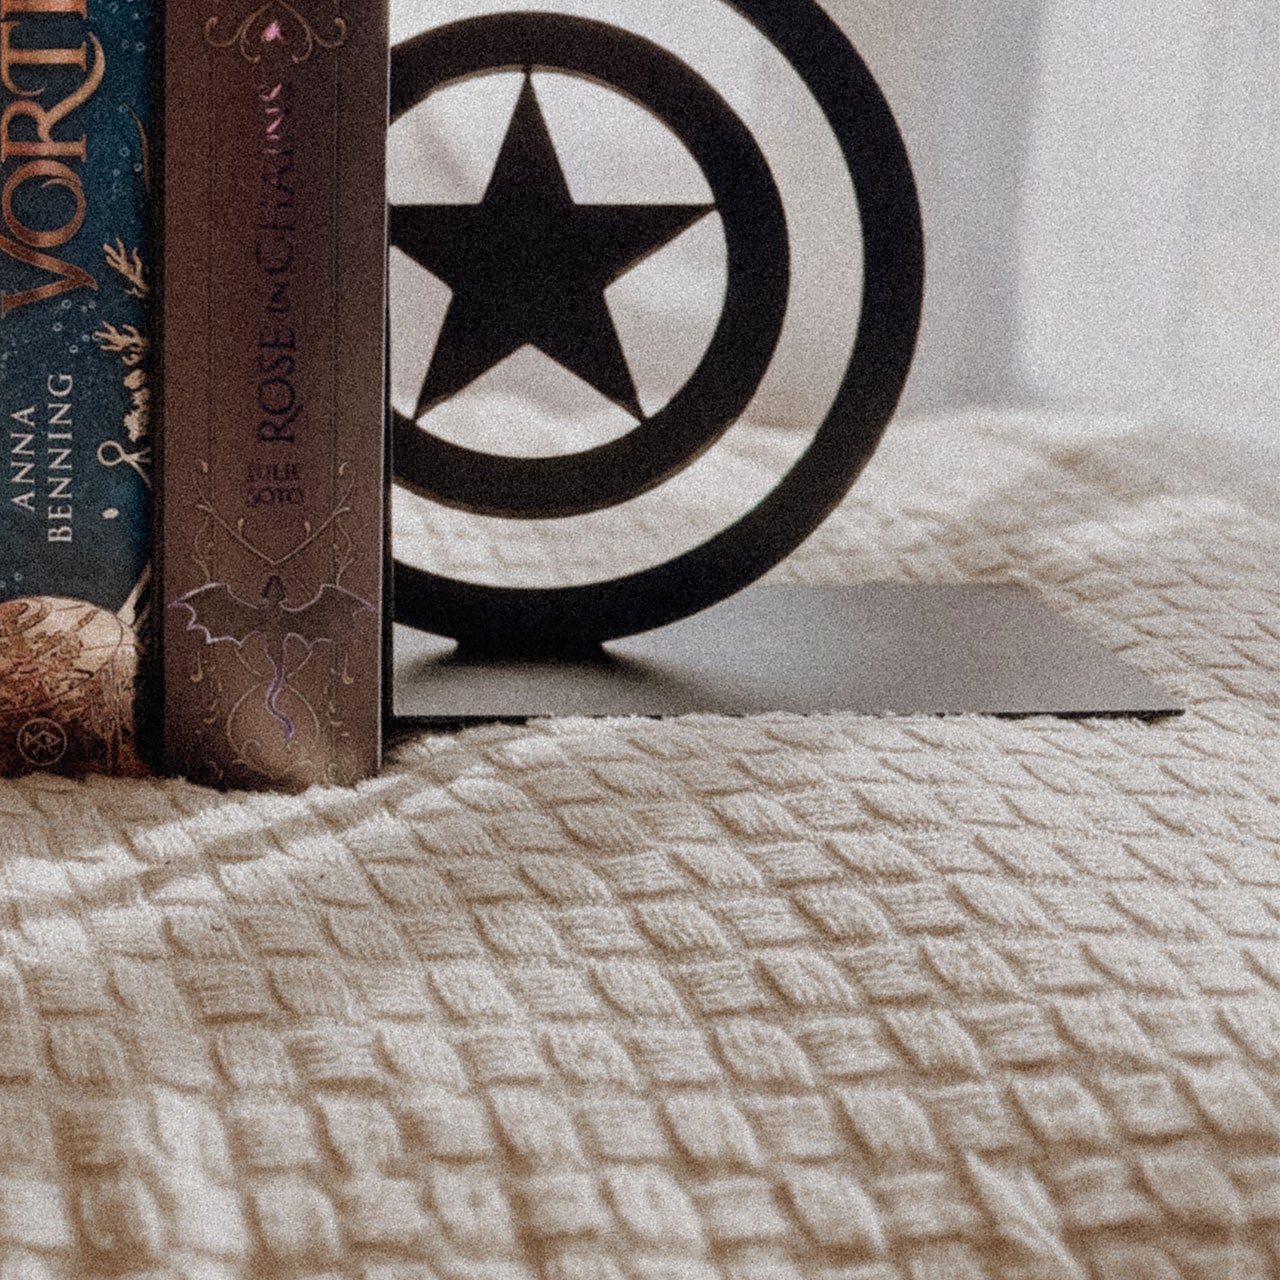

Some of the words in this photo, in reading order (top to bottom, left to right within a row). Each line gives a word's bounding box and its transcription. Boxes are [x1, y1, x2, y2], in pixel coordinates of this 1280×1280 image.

[255, 82, 297, 275] CHAINS
[256, 326, 304, 445] ROSE
[10, 405, 36, 512] ANNA
[47, 373, 73, 543] BENNING
